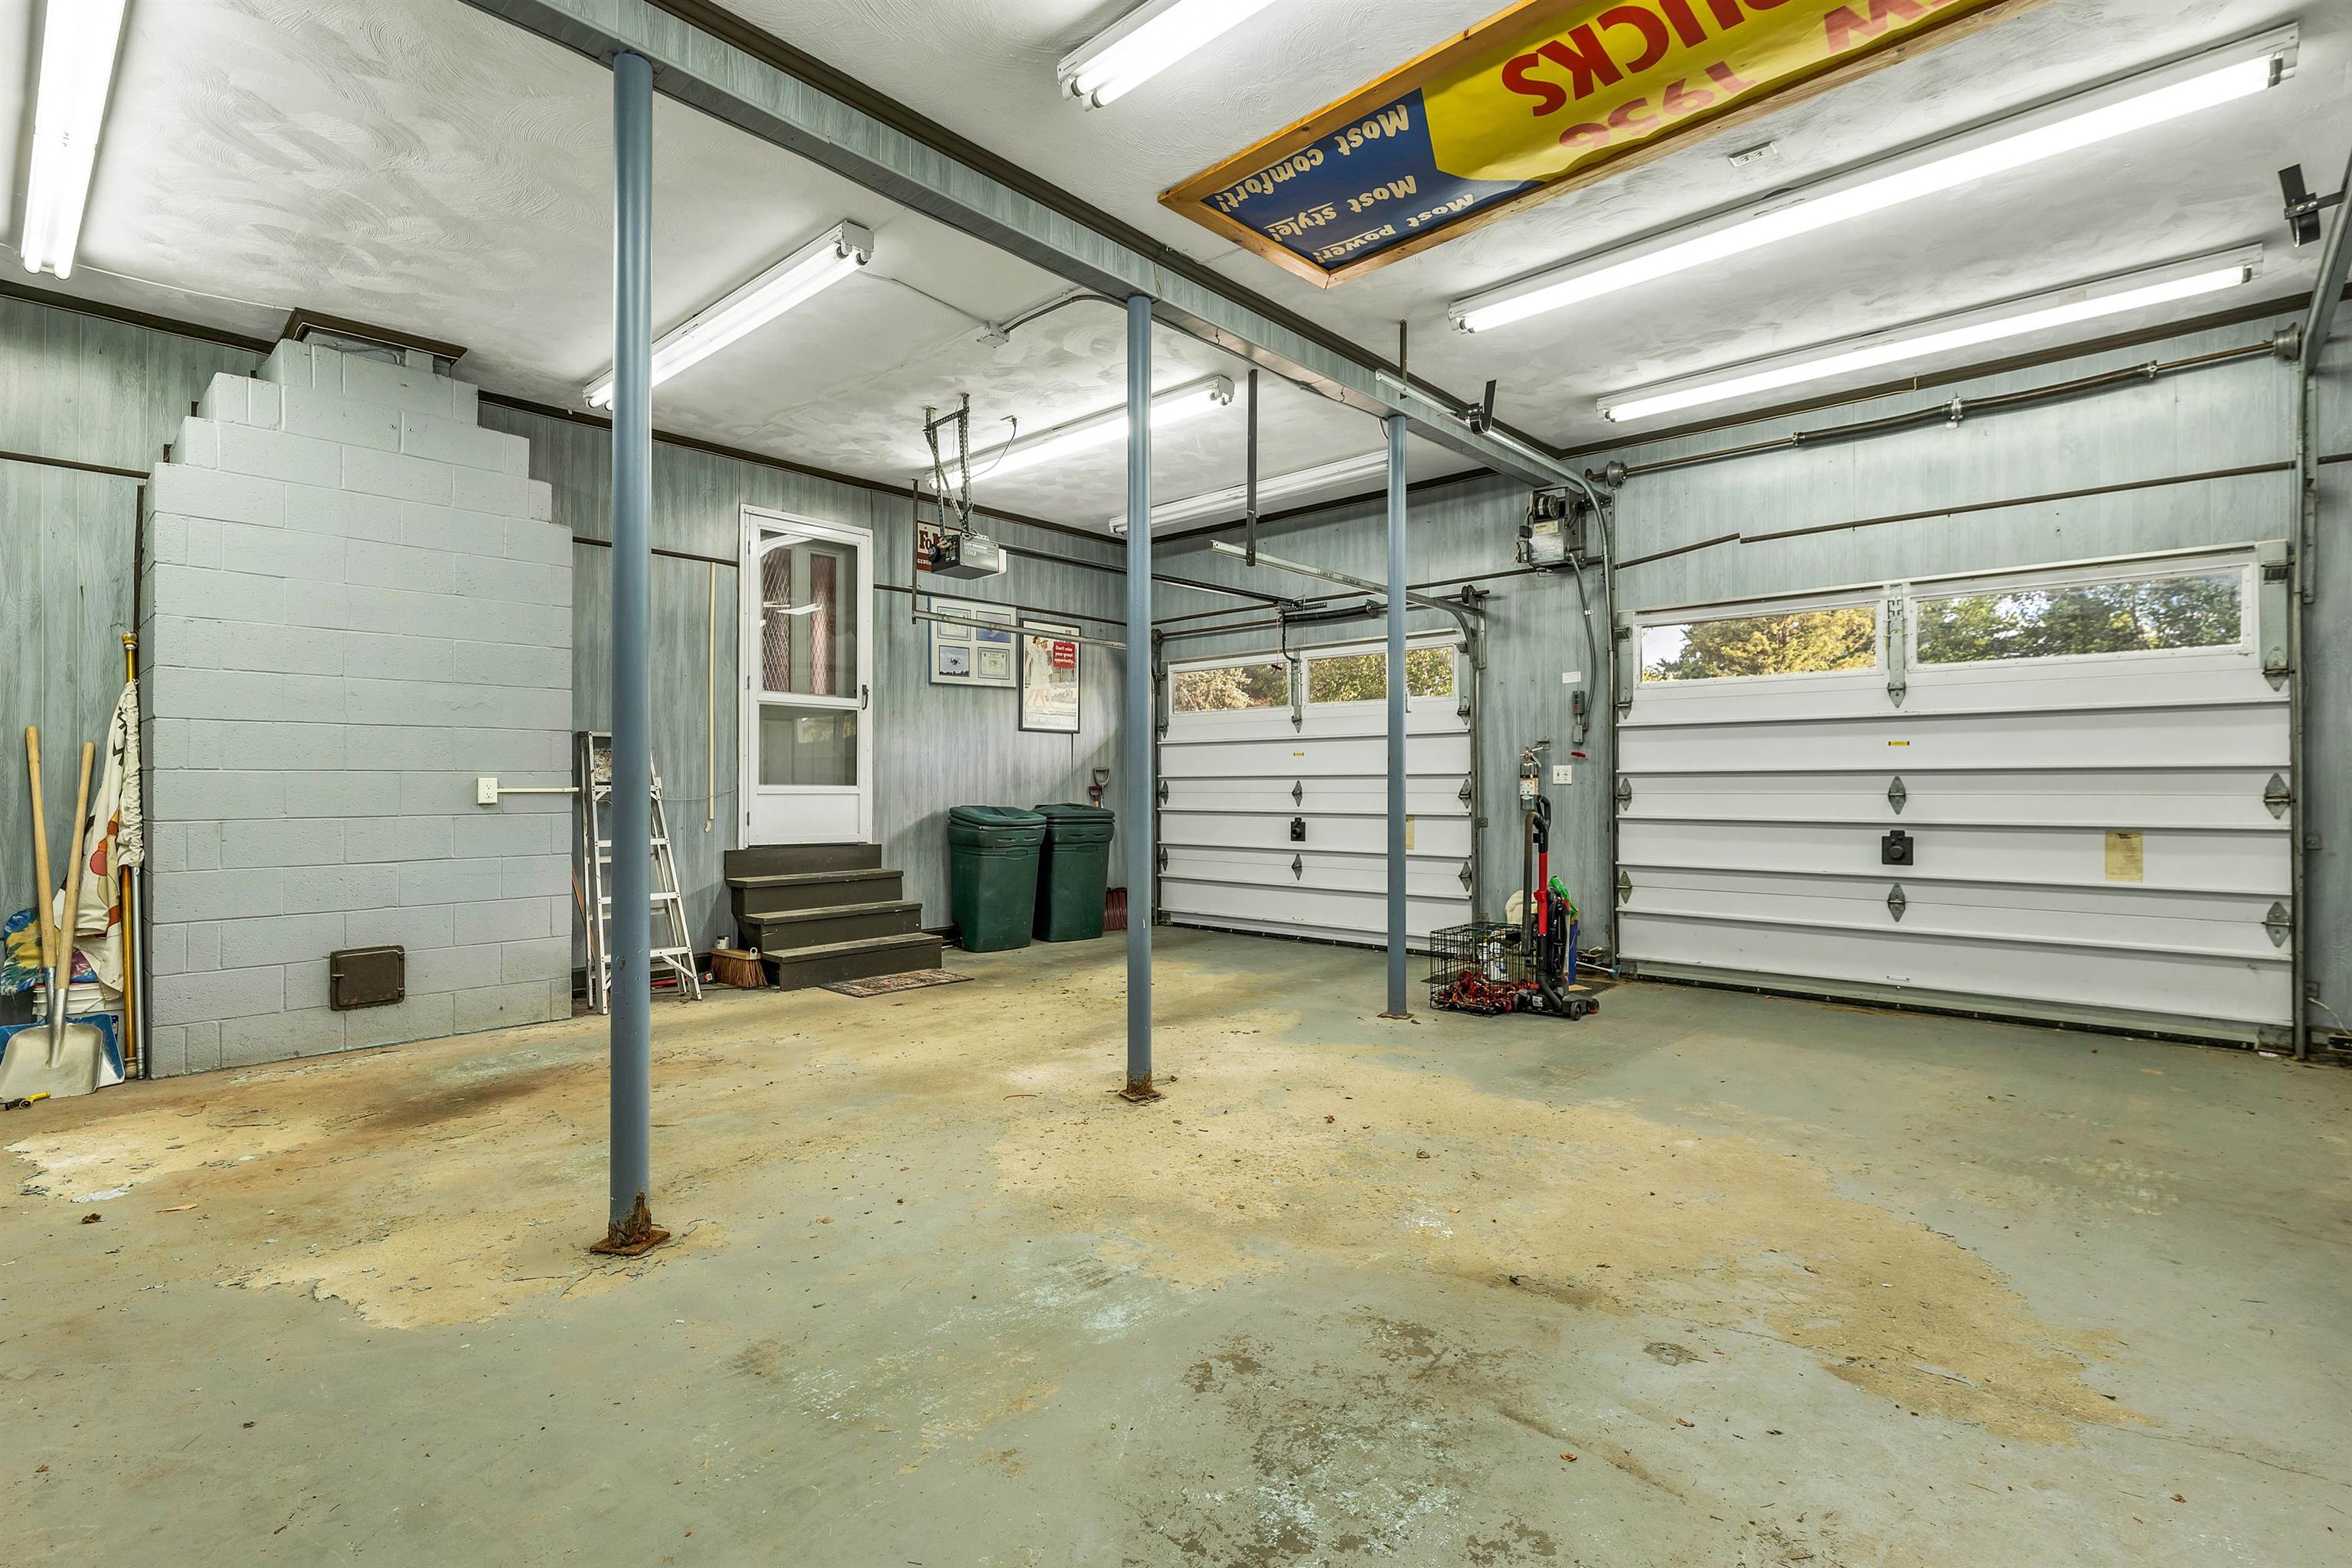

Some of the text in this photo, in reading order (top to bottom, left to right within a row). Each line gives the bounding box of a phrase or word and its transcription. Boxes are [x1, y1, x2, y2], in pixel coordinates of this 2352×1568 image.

[1501, 0, 1793, 117] UCKS
[1559, 60, 1757, 149] 1956
[1216, 104, 1410, 214] Most comfort!
[1269, 175, 1417, 243] Most style!
[1315, 193, 1475, 264] Most power!
